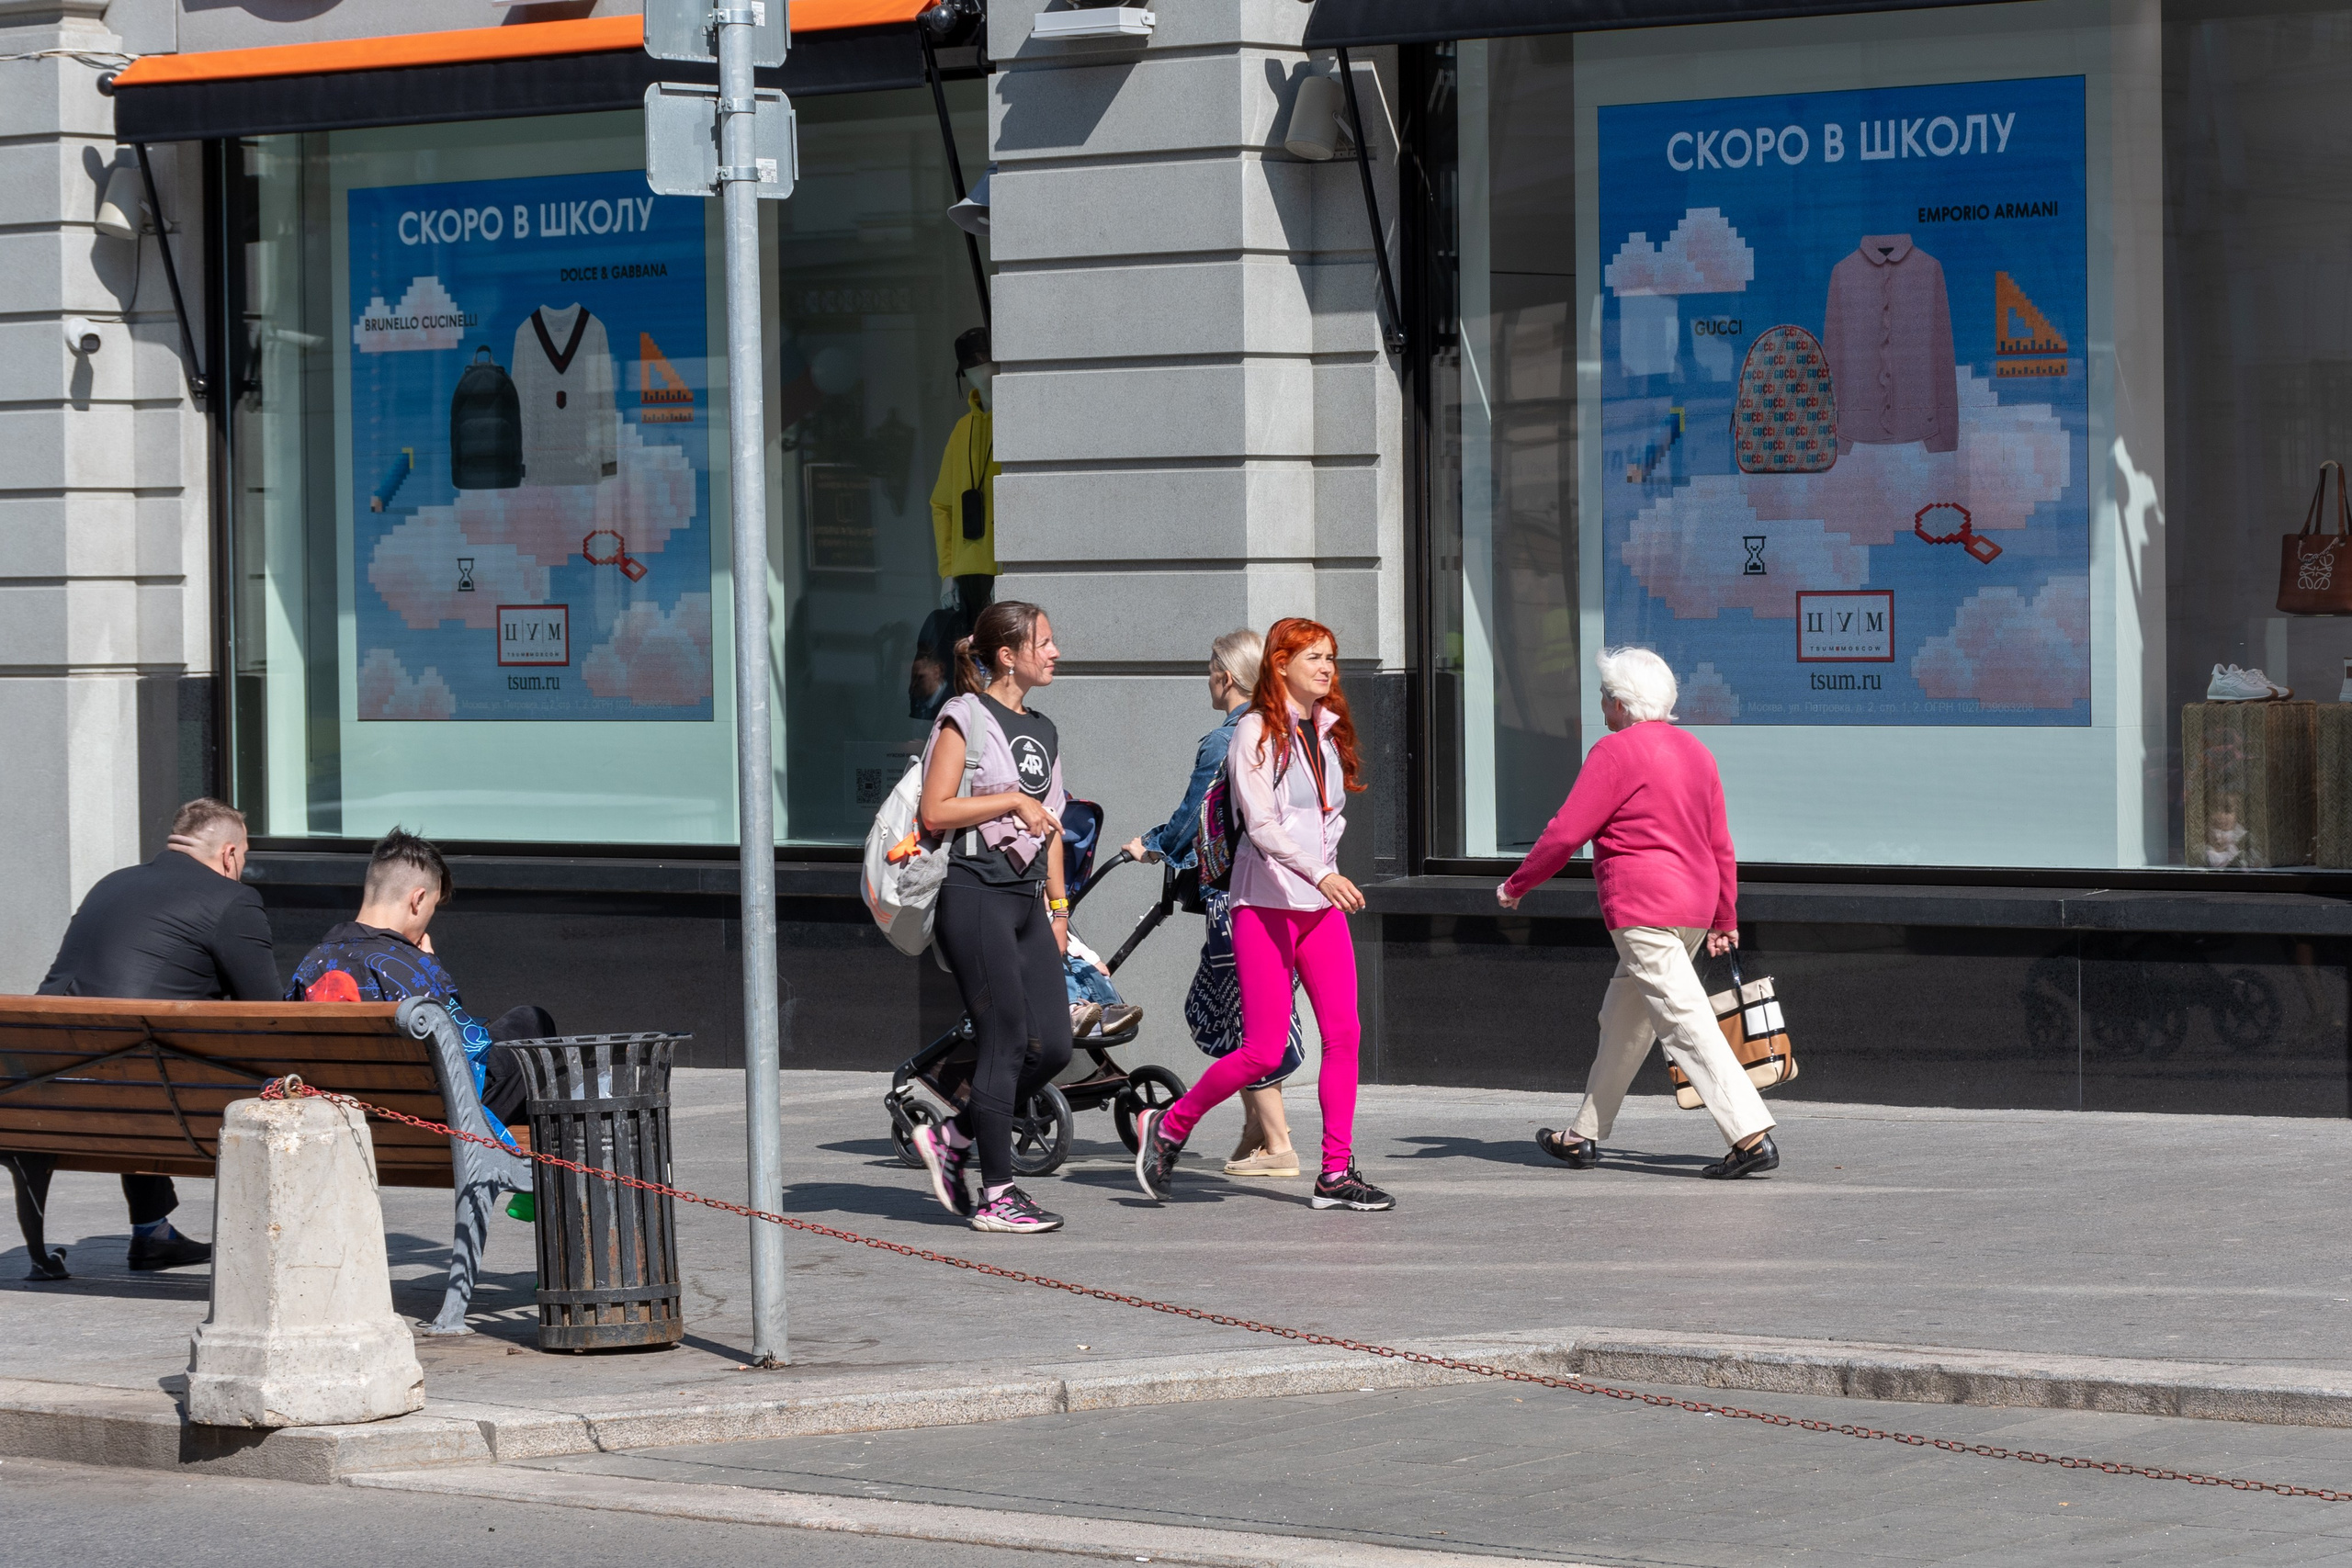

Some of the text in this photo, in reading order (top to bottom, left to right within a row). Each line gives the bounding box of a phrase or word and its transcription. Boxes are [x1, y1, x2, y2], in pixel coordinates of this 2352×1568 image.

[1667, 112, 2016, 172] СКОРО В ШКОЛУ
[1918, 200, 2058, 223] EMPORIO ARMANI
[398, 197, 654, 245] СКОРО В ШКОЛУ
[560, 264, 668, 282] DOLCE & GABBANA
[365, 314, 478, 332] BRUNELLO CUCINELLI
[1694, 319, 1742, 336] GUCCI
[1786, 341, 1809, 350] GUCCI
[1764, 355, 1786, 365] GUCCI
[1796, 355, 1818, 364] GUCCI
[1774, 369, 1797, 378] GUCCI
[1753, 384, 1775, 393] GUCCI
[1786, 383, 1808, 393] GUCCI
[1763, 398, 1785, 408] GUCCI
[1796, 398, 1818, 408] GUCCI
[1742, 412, 1764, 422] GUCCI
[1774, 412, 1796, 422] GUCCI
[1807, 411, 1828, 421] GUCCI
[1753, 426, 1775, 436] GUCCI
[1785, 426, 1808, 435] GUCCI
[1763, 441, 1785, 450] GUCCI
[1796, 440, 1818, 449] GUCCI
[1742, 455, 1764, 463] GUCCI
[1774, 455, 1796, 463] GUCCI
[1806, 453, 1827, 463] GUCCI
[508, 674, 560, 690] tsum.ru
[1810, 672, 1882, 690] tsum.ru
[1924, 702, 1954, 713] ОГРН
